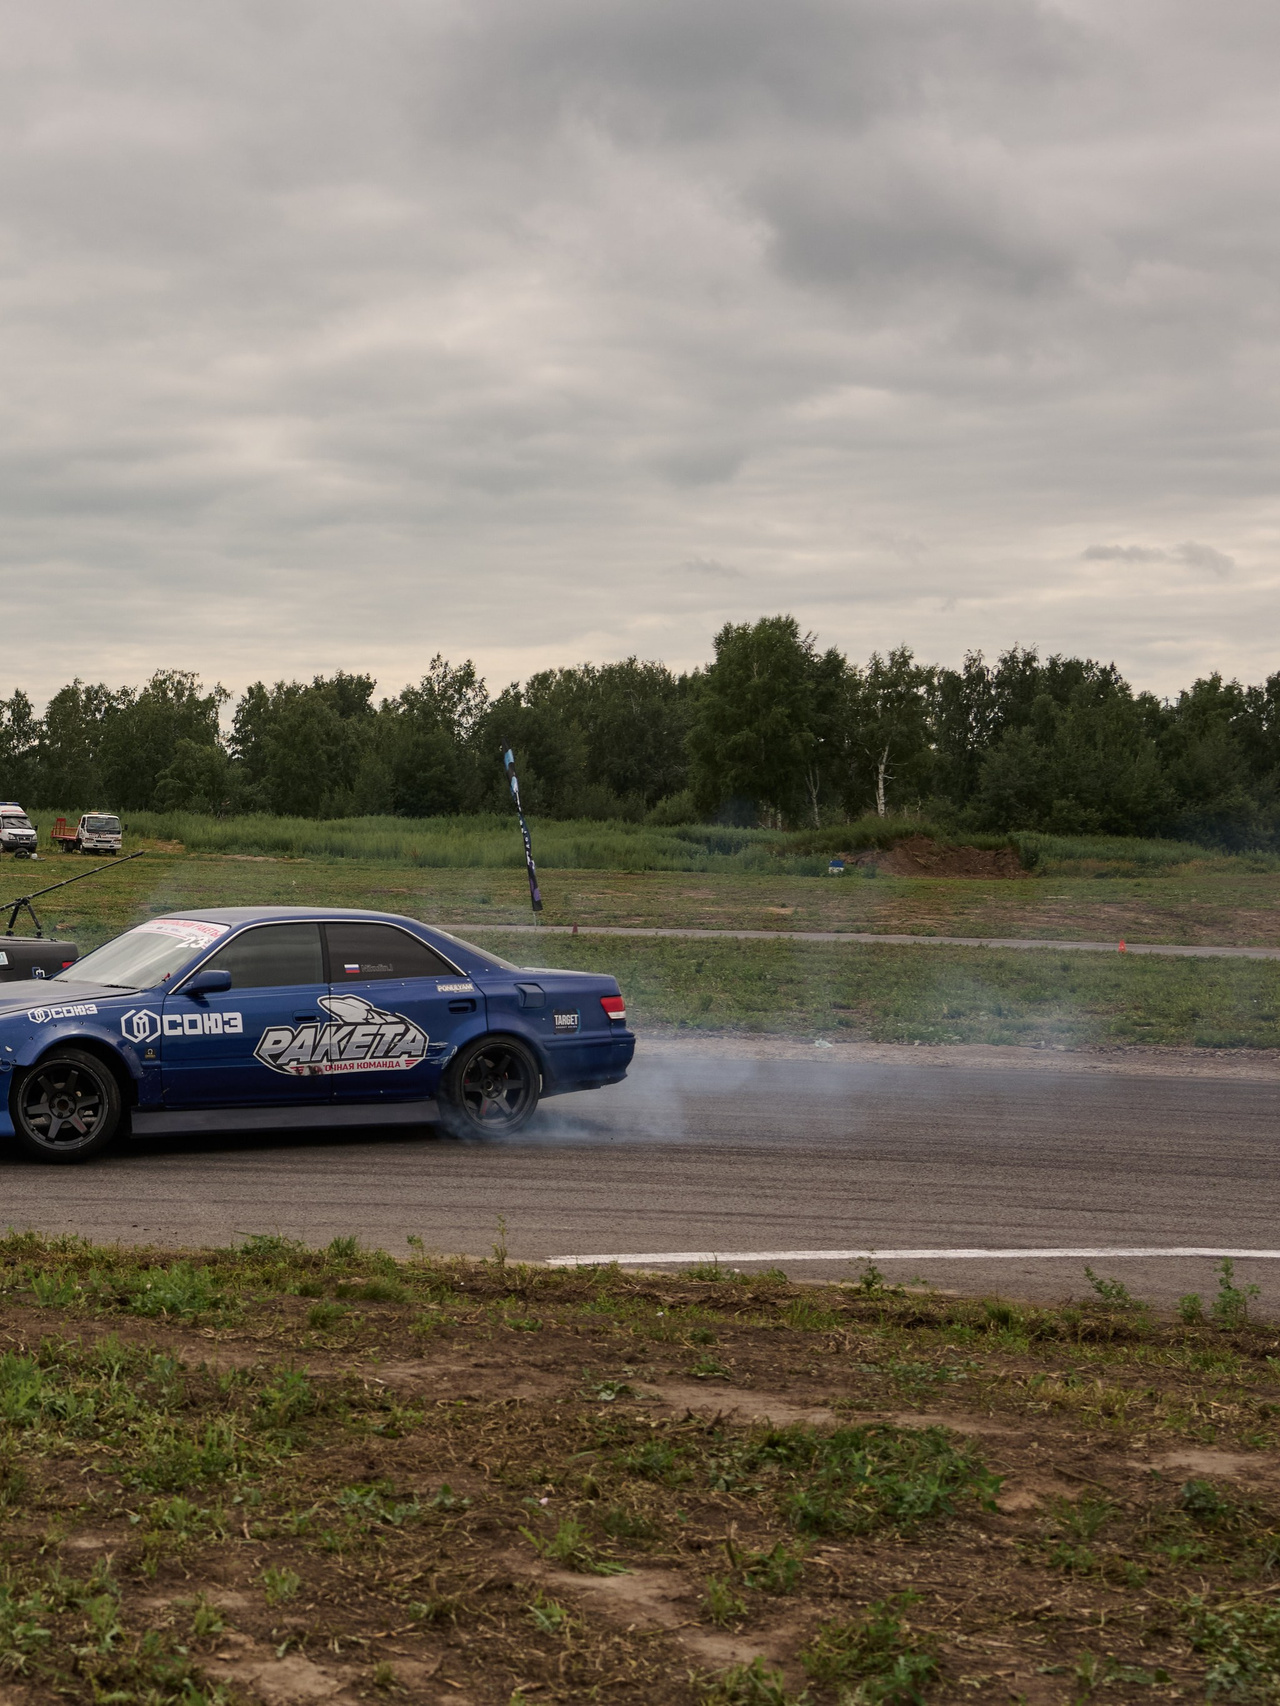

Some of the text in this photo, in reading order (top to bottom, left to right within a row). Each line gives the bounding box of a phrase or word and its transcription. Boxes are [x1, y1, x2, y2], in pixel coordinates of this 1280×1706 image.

[176, 936, 208, 948] 23
[50, 1003, 98, 1019] СОЮЗ
[162, 1011, 244, 1036] СОЮЗ
[554, 1014, 579, 1026] TARGET
[259, 1023, 425, 1064] РАКЕТА
[356, 1060, 401, 1070] КОМАНДА
